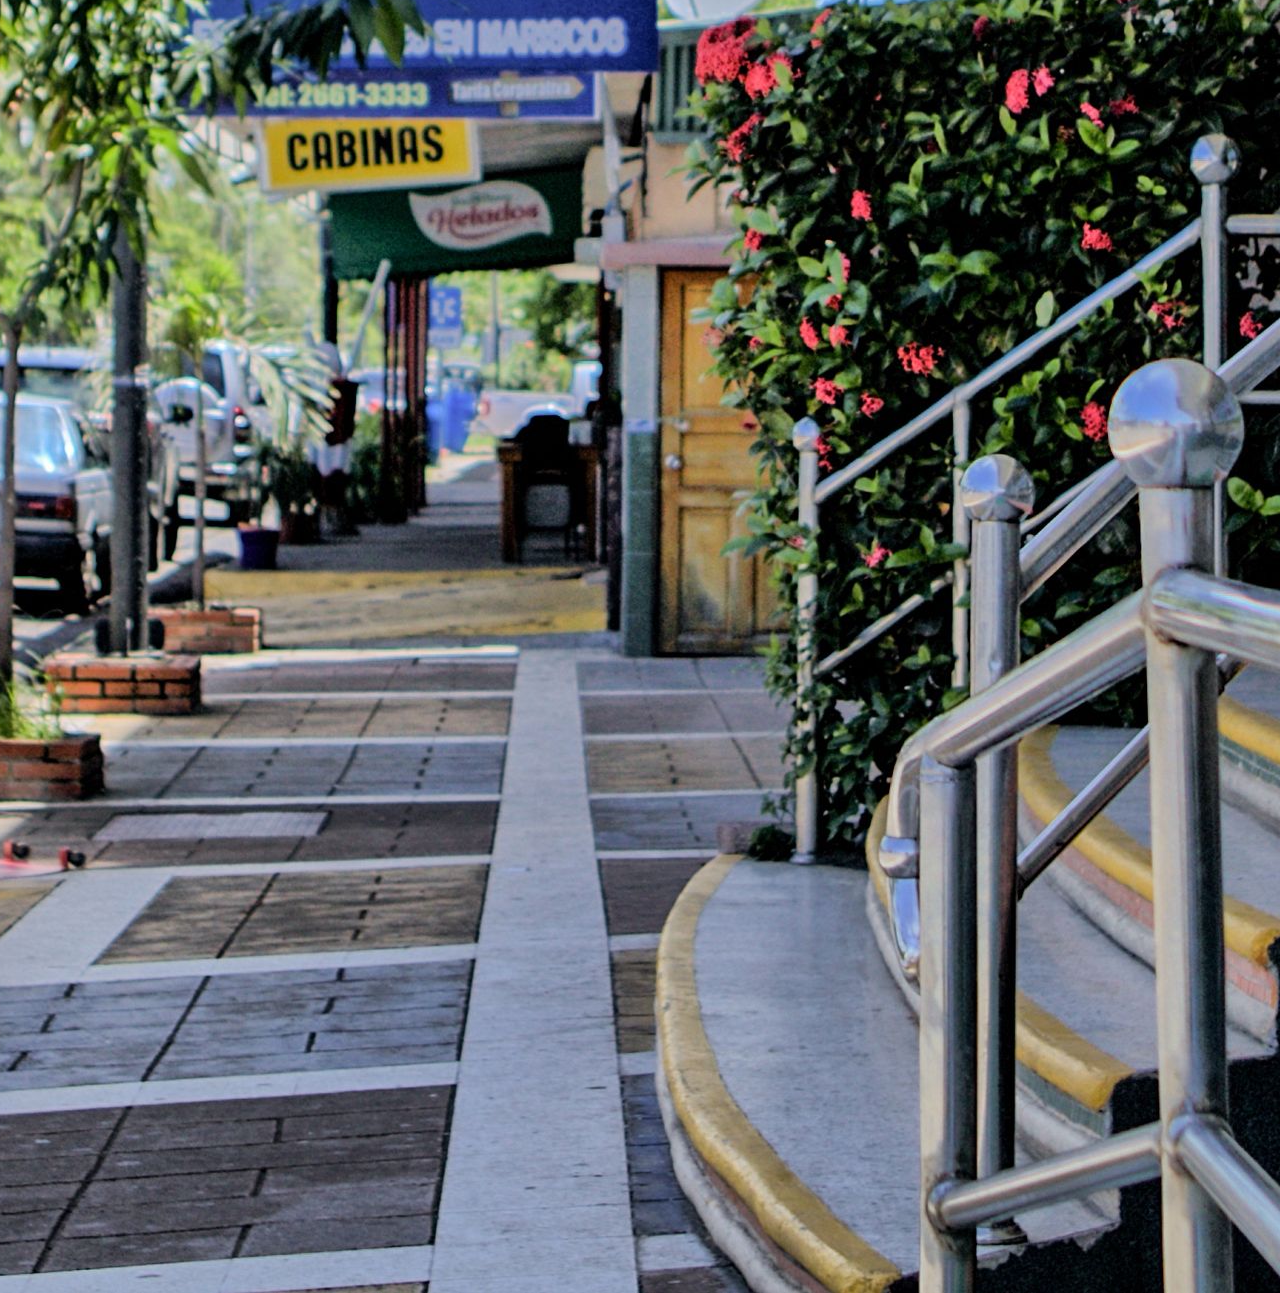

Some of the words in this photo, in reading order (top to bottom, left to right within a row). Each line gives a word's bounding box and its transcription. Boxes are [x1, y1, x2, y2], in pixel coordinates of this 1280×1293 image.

[434, 19, 474, 57] EN
[477, 16, 628, 57] MARISCOS
[297, 82, 430, 108] 2661-3333
[286, 123, 444, 172] CABINAS
